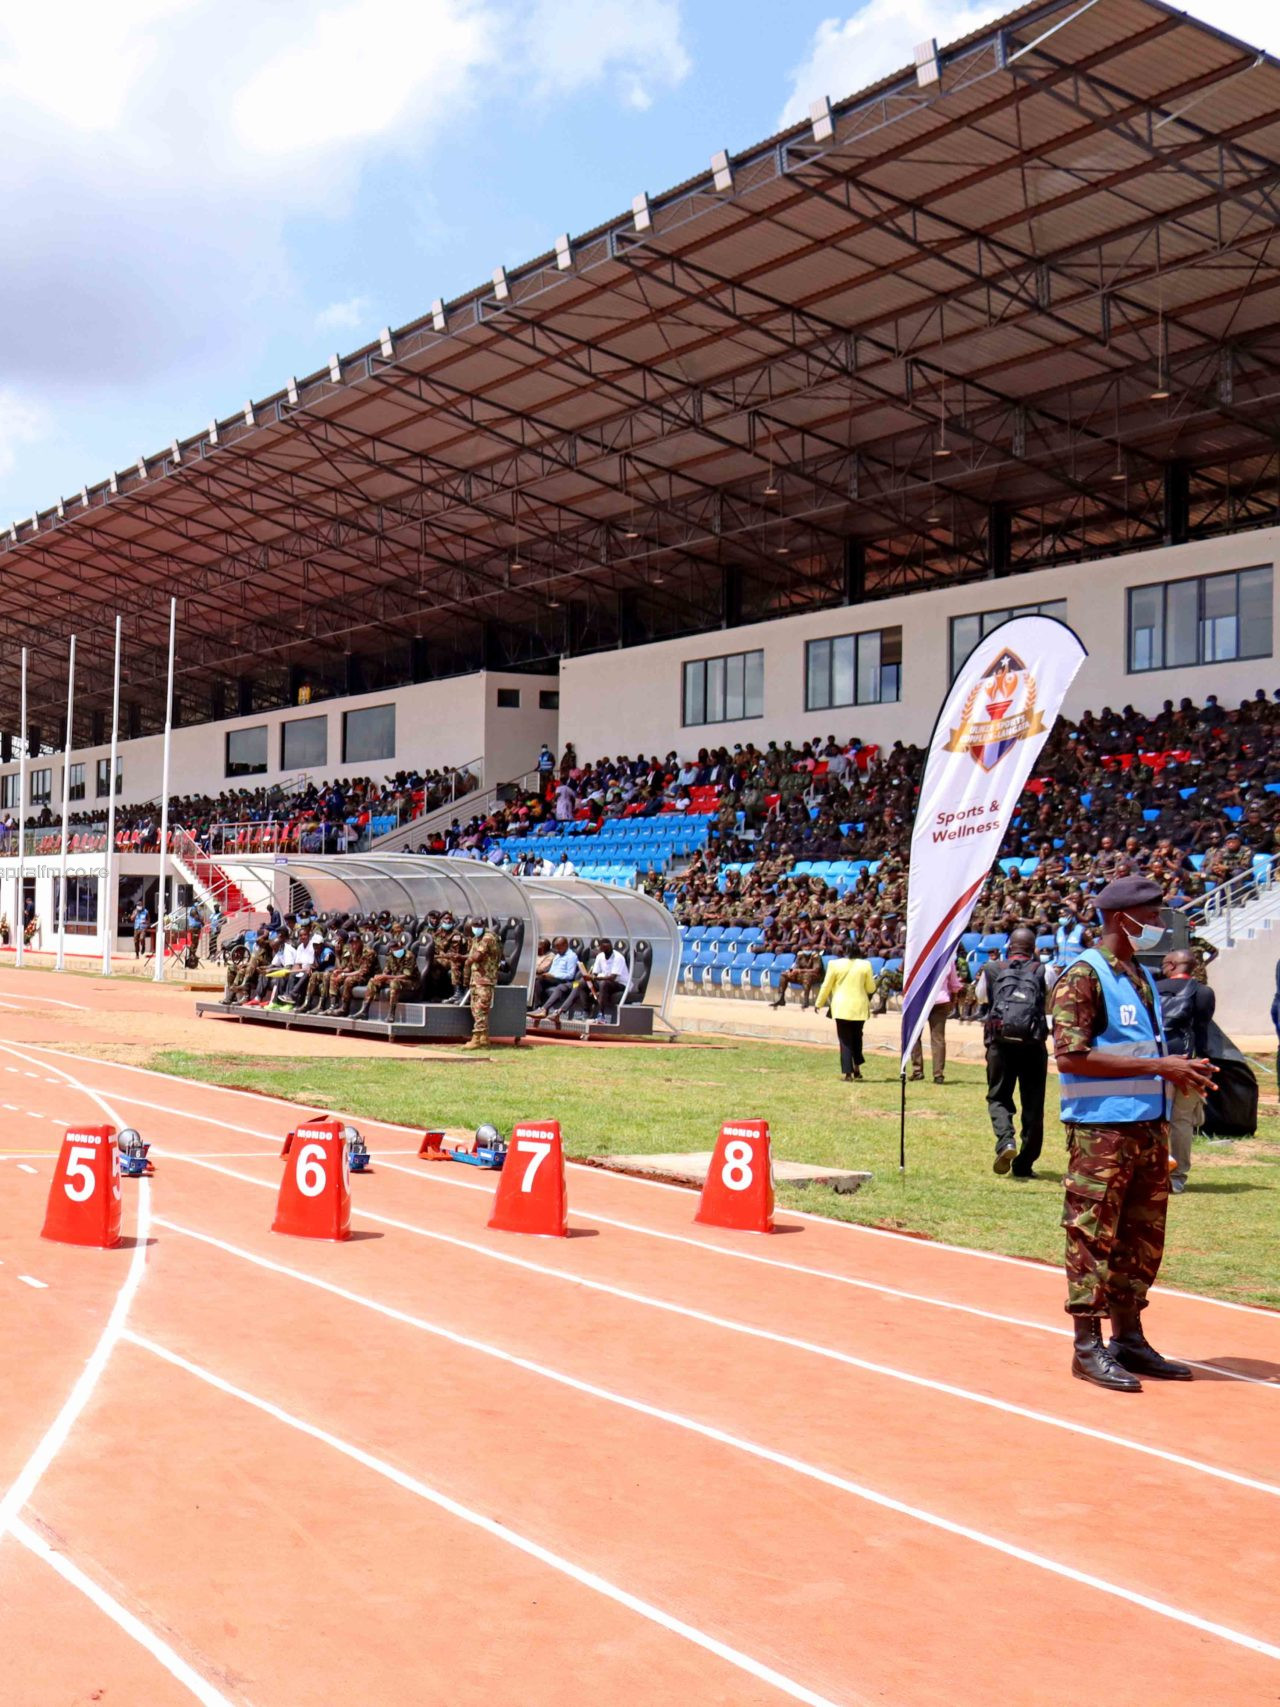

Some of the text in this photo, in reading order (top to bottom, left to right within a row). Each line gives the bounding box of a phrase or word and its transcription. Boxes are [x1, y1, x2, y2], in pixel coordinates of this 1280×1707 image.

[932, 821, 1000, 843] Wellness
[936, 800, 1000, 827] Sports &
[1120, 1004, 1138, 1026] 62
[64, 1146, 96, 1202] 5
[296, 1143, 327, 1197] 6
[517, 1140, 551, 1193] 7
[721, 1140, 753, 1191] 8
